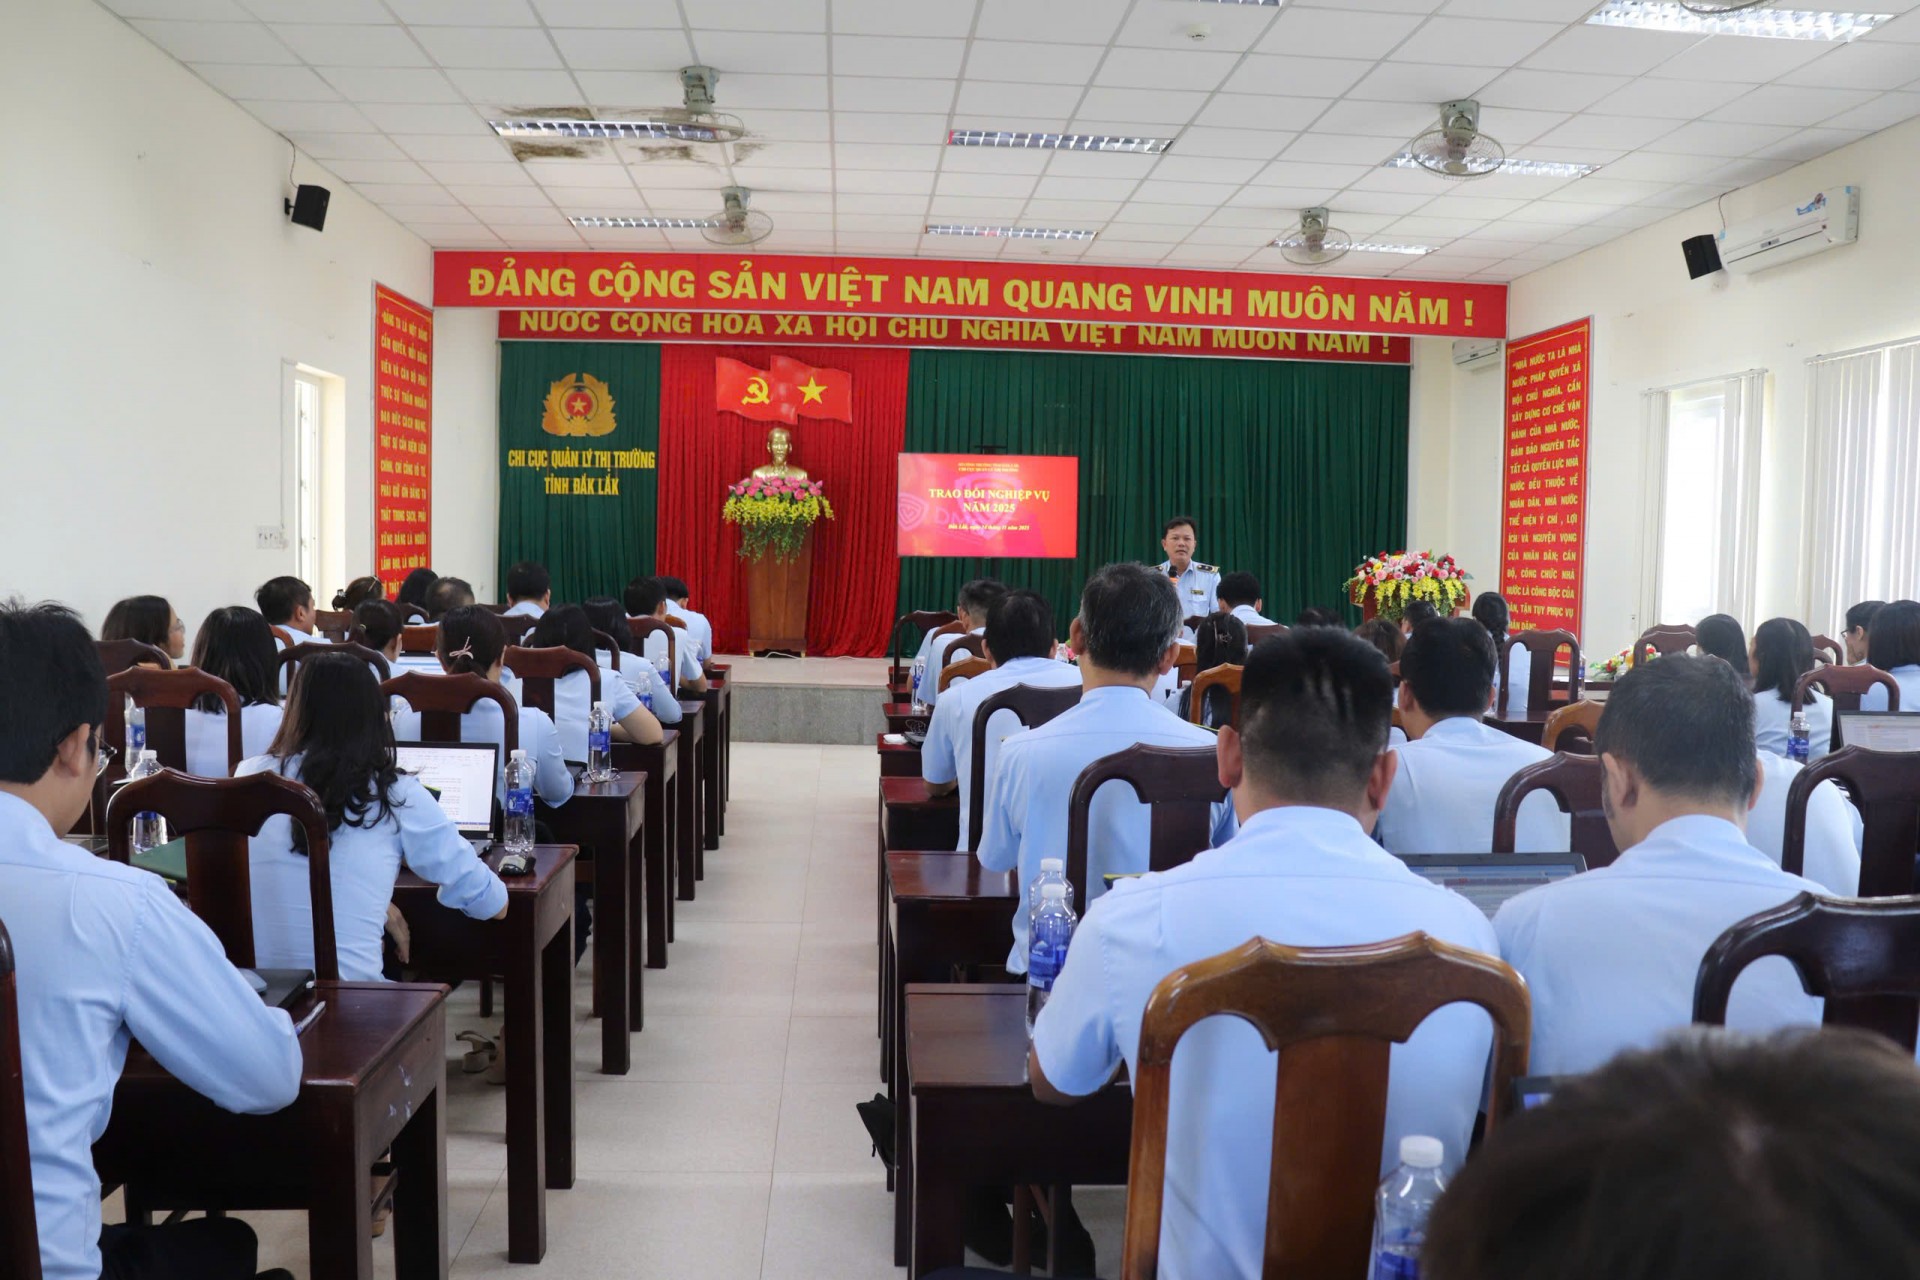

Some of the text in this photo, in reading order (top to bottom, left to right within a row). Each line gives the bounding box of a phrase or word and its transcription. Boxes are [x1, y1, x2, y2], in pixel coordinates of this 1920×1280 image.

[469, 257, 1473, 326] ĐẢNG CỘNG SẢN VIỆT NAM QUANG VINH MUÔN NĂM !
[1138, 325, 1201, 347] NAM
[508, 446, 655, 472] CHI CỤC QUẢN LÝ THỊ TRƯỜNG
[544, 473, 619, 495] TỈNH ĐẮK LẮK
[963, 501, 1015, 513] NĂM 2025
